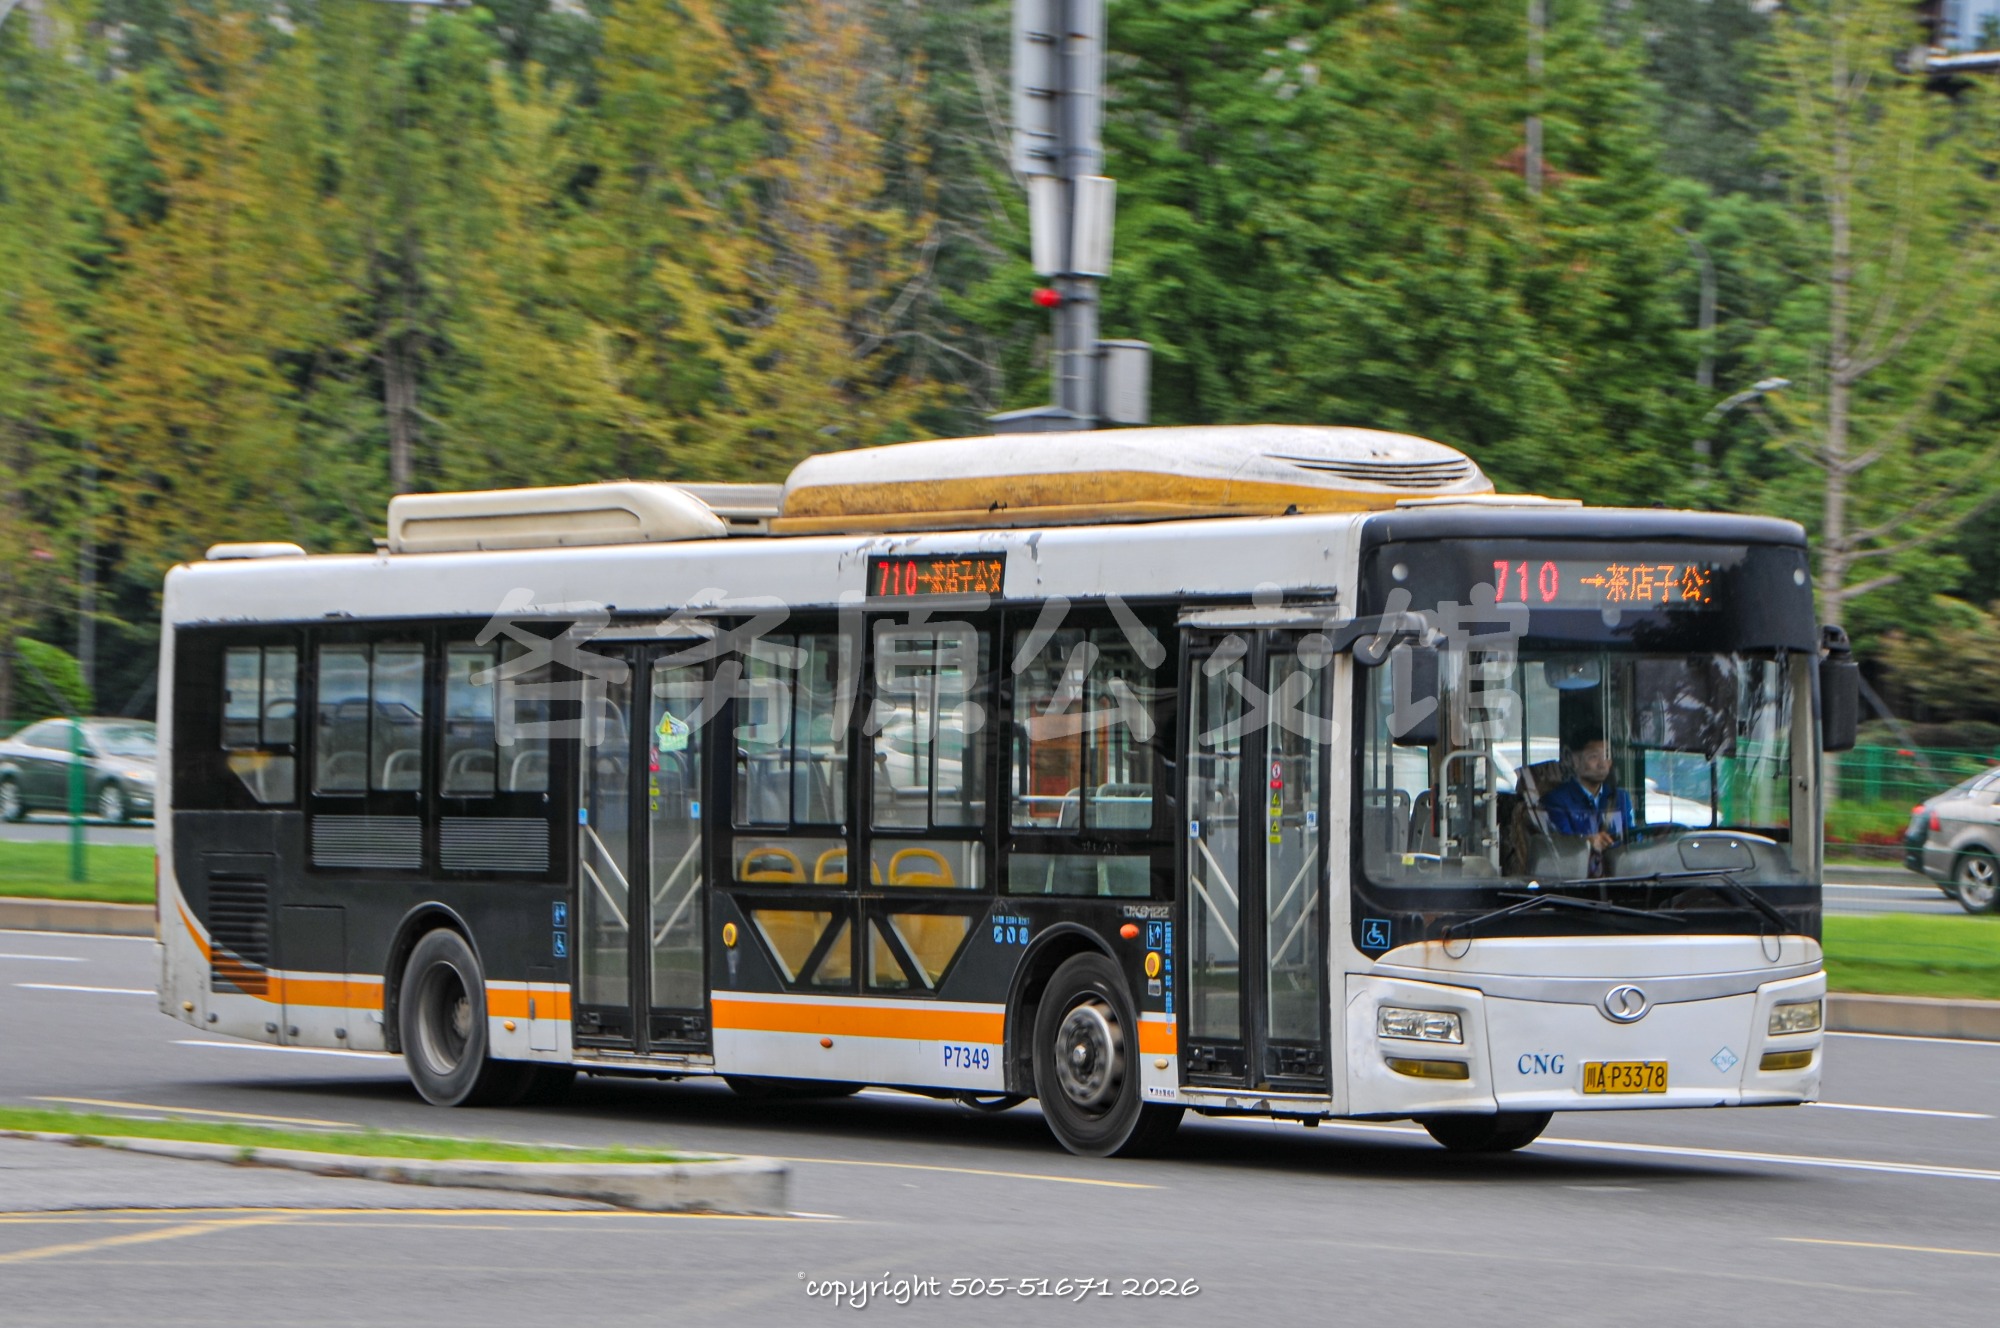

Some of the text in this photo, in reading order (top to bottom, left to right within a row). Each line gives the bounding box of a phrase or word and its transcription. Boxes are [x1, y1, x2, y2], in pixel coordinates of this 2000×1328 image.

[878, 561, 918, 596] 710
[1493, 560, 1711, 603] 710 茶店子公
[944, 1045, 990, 1070] P7349
[1518, 1053, 1565, 1075] CNG
